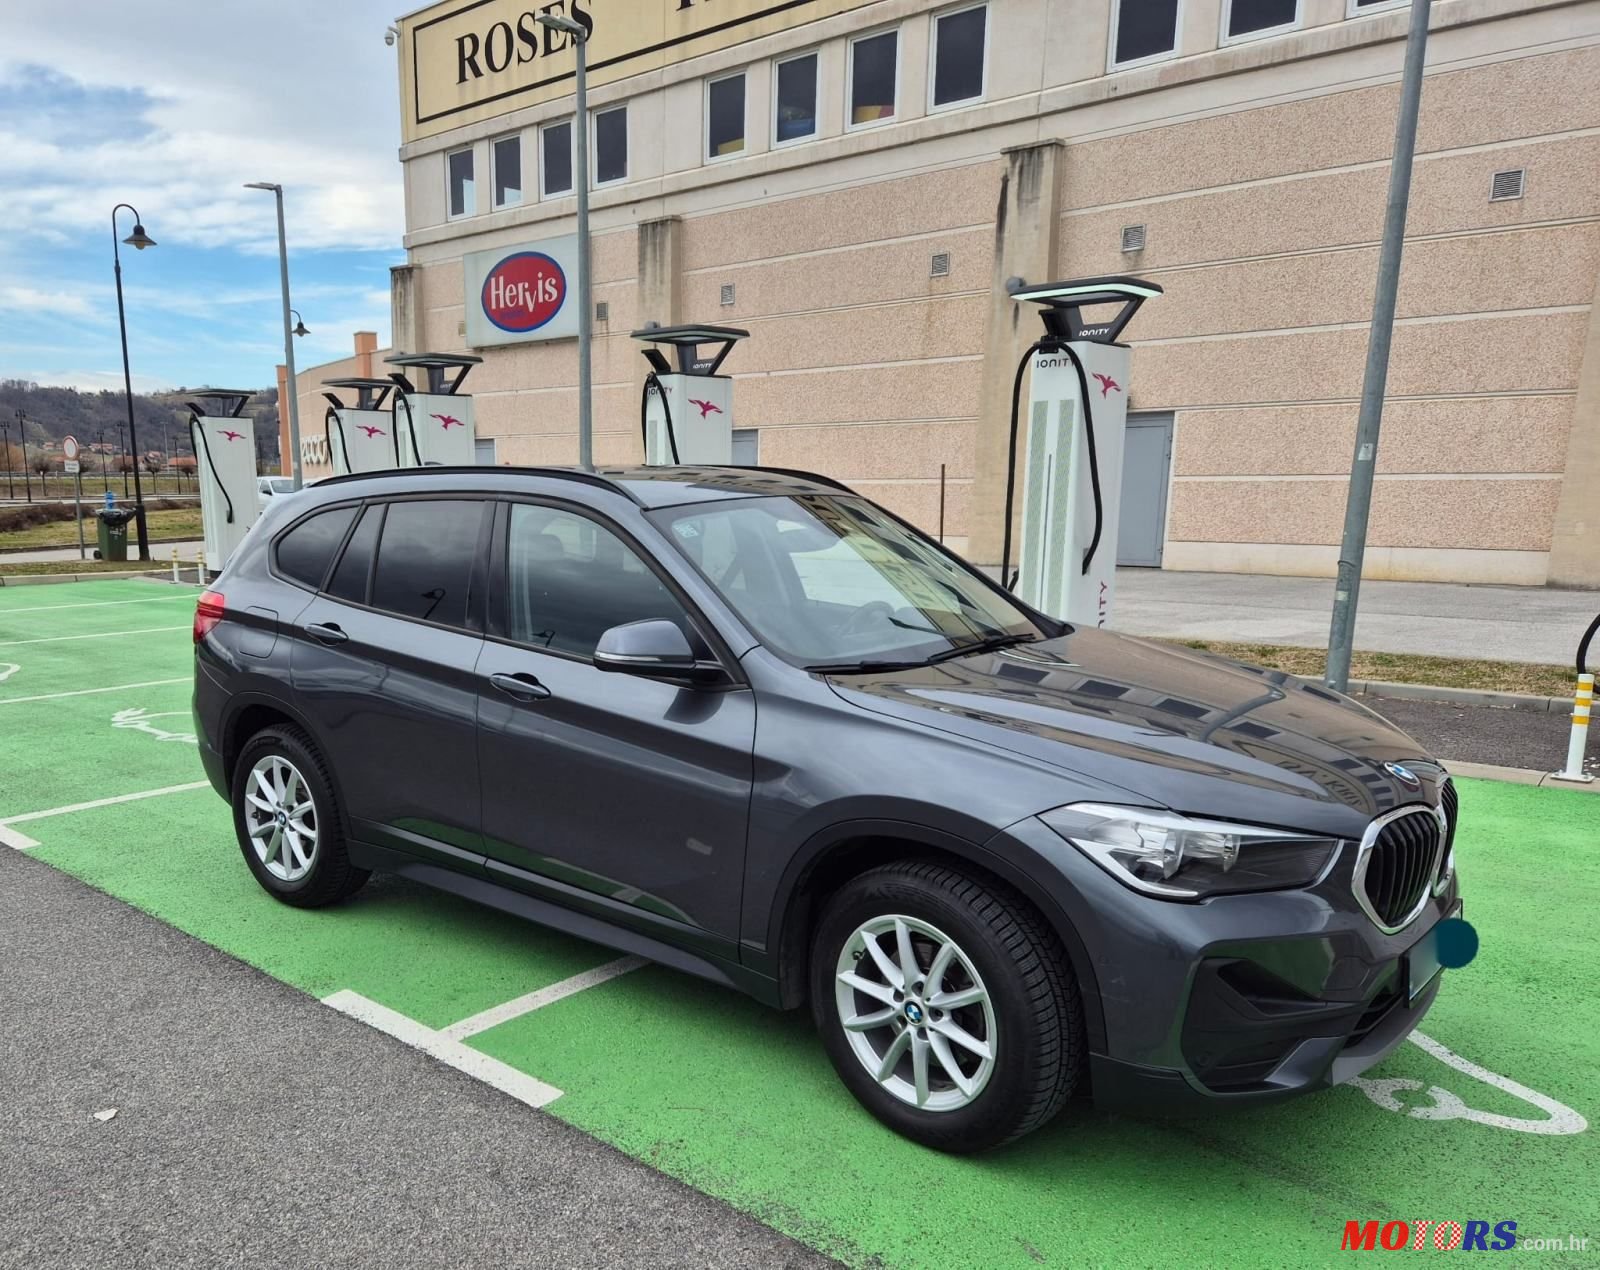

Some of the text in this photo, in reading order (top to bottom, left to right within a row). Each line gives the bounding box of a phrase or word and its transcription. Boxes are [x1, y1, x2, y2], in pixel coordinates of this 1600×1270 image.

[455, 0, 594, 85] ROSES
[490, 271, 559, 314] Hervis
[1078, 328, 1110, 337] IONITY
